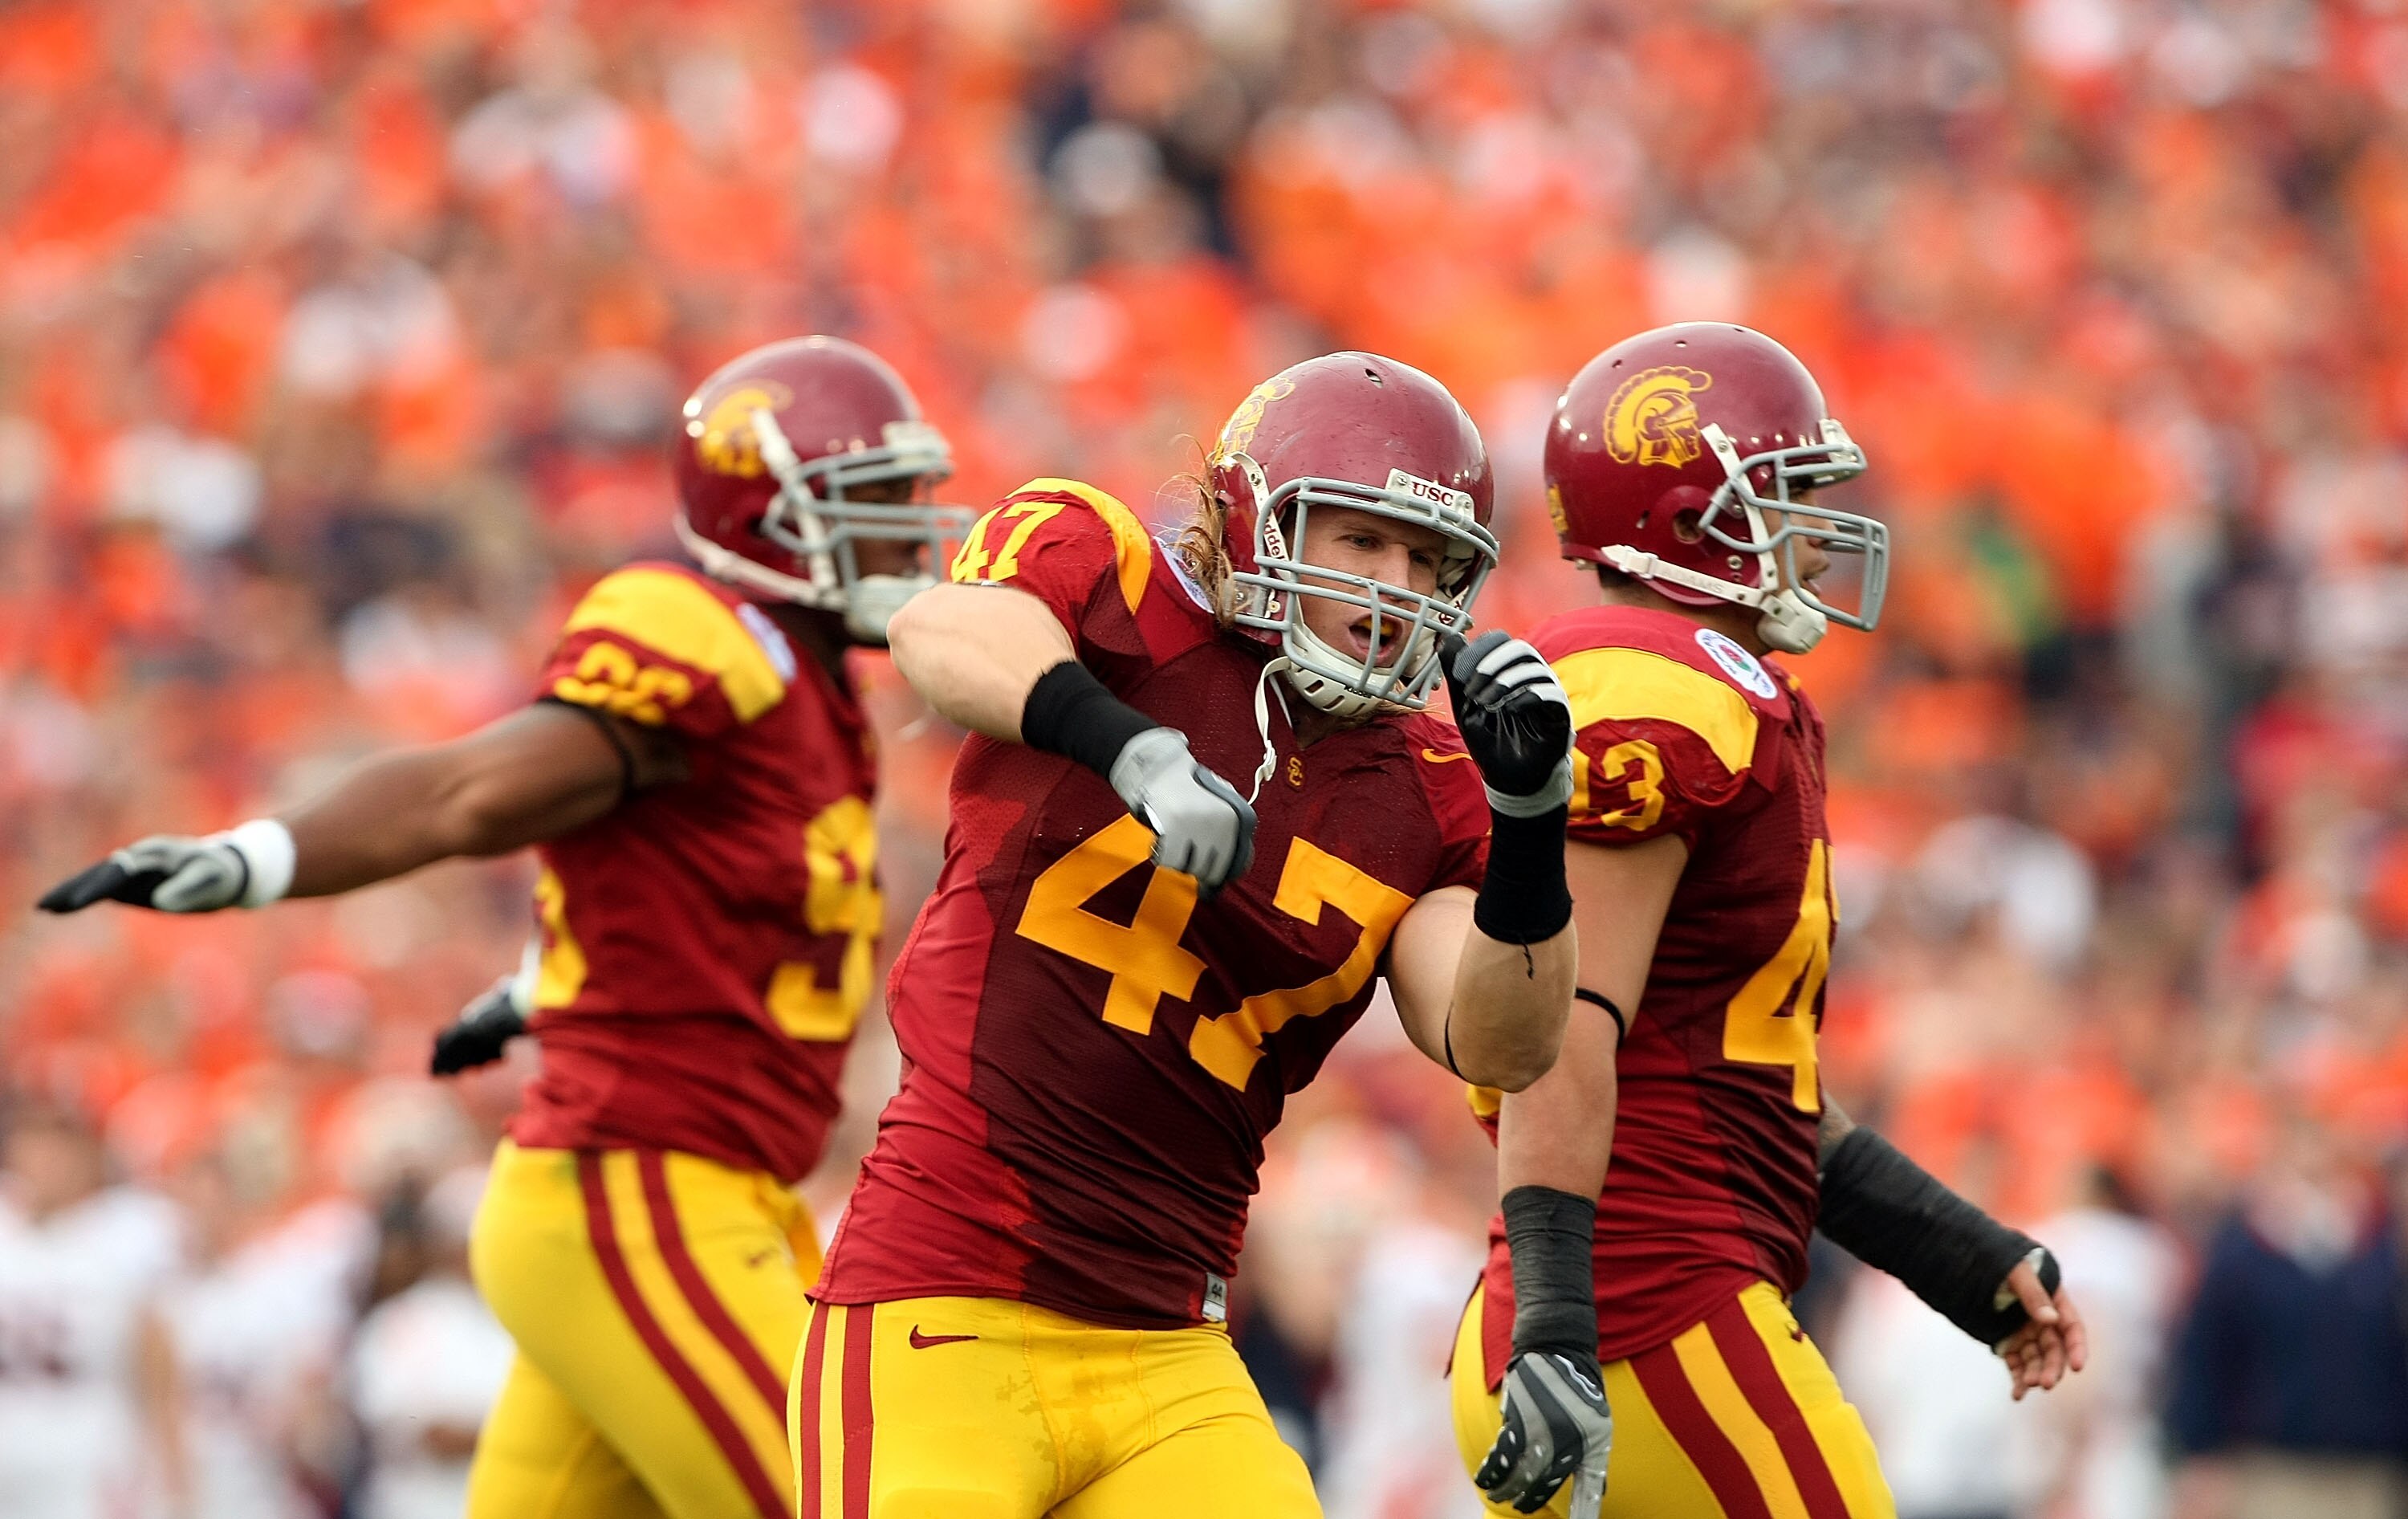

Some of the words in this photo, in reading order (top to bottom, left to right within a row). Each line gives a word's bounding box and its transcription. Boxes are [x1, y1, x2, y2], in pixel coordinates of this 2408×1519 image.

[1412, 482, 1454, 506] USC
[951, 501, 1066, 583] 47
[1015, 812, 1415, 1093] 47
